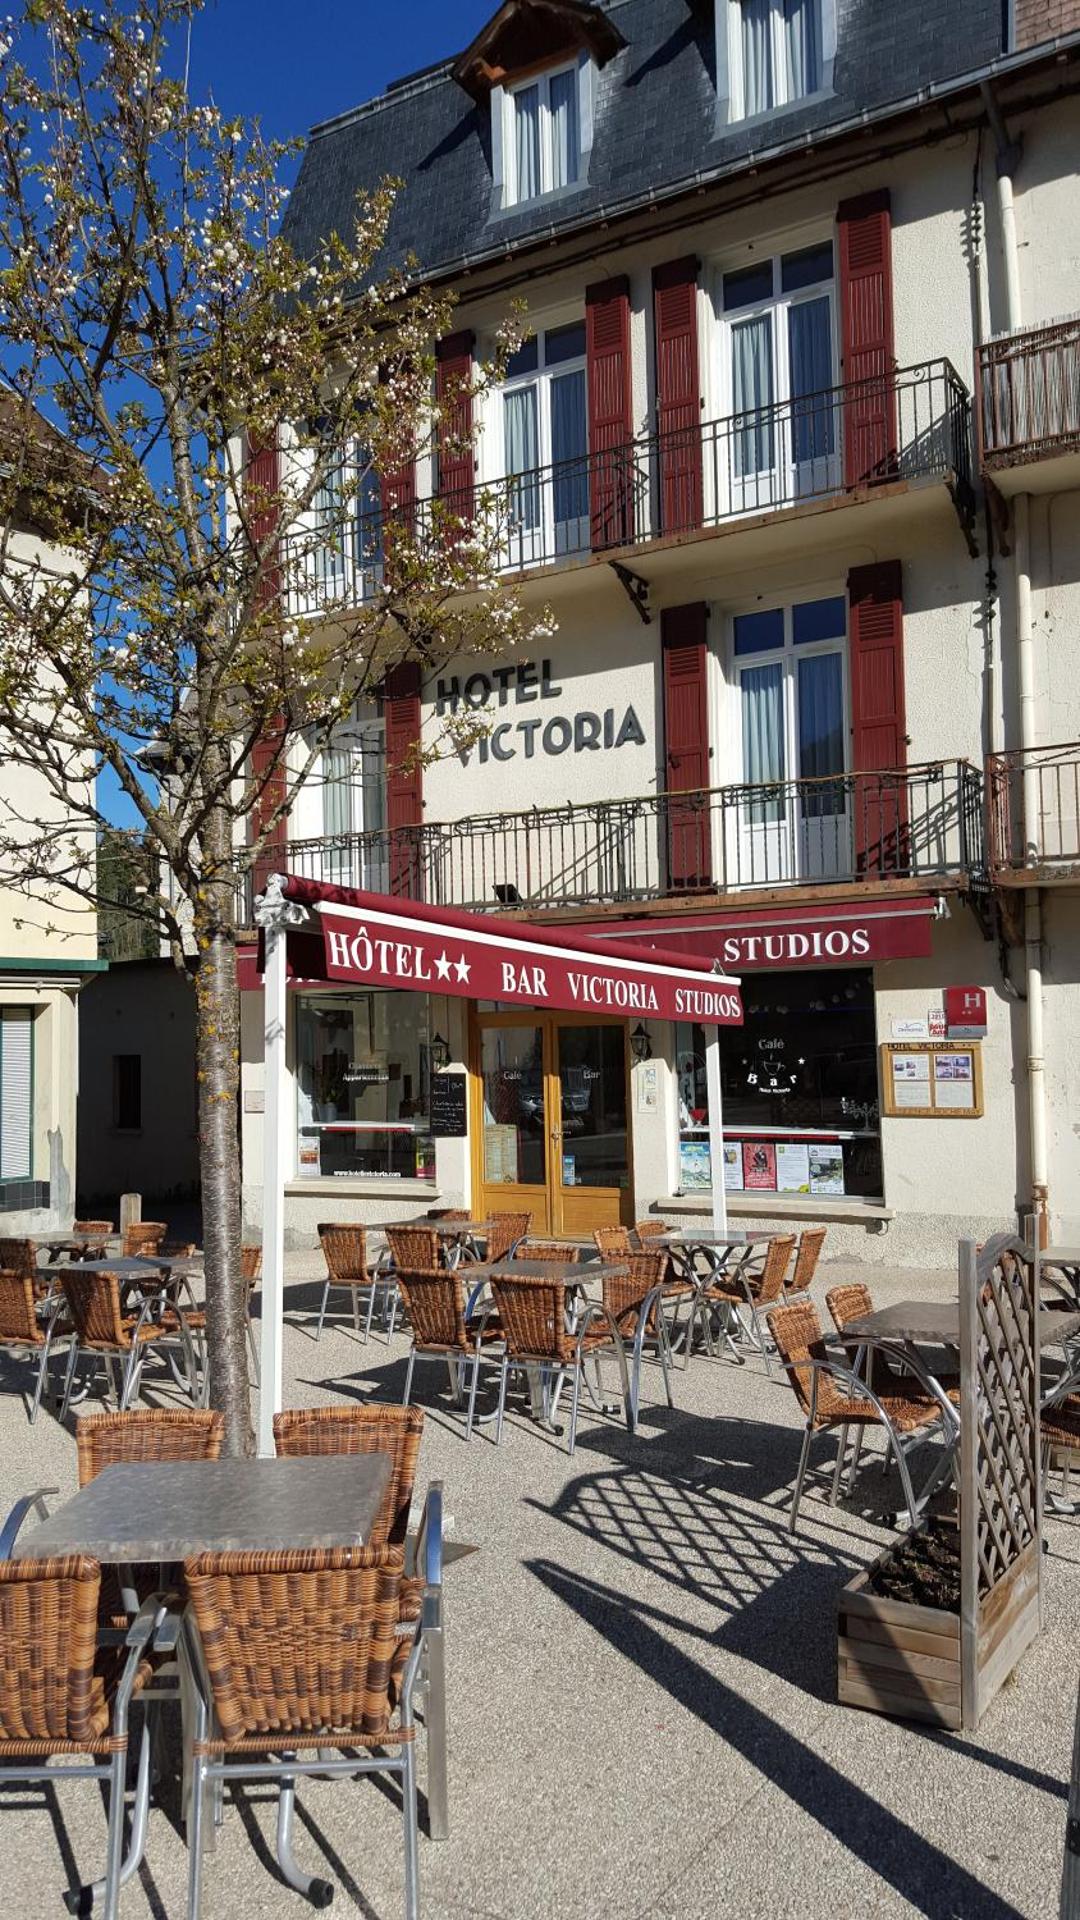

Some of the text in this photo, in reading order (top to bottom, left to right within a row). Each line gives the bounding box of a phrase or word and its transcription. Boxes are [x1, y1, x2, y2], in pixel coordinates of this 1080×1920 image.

[434, 659, 562, 717] HOTEL
[449, 702, 646, 768] VICTORIA
[723, 928, 870, 963] STUDIOS
[327, 926, 741, 1017] HÔTEL BAR VICTORIA STUDIOS
[964, 992, 981, 1008] H
[918, 1042, 955, 1050] VICTORIA
[583, 1069, 601, 1079] Bar
